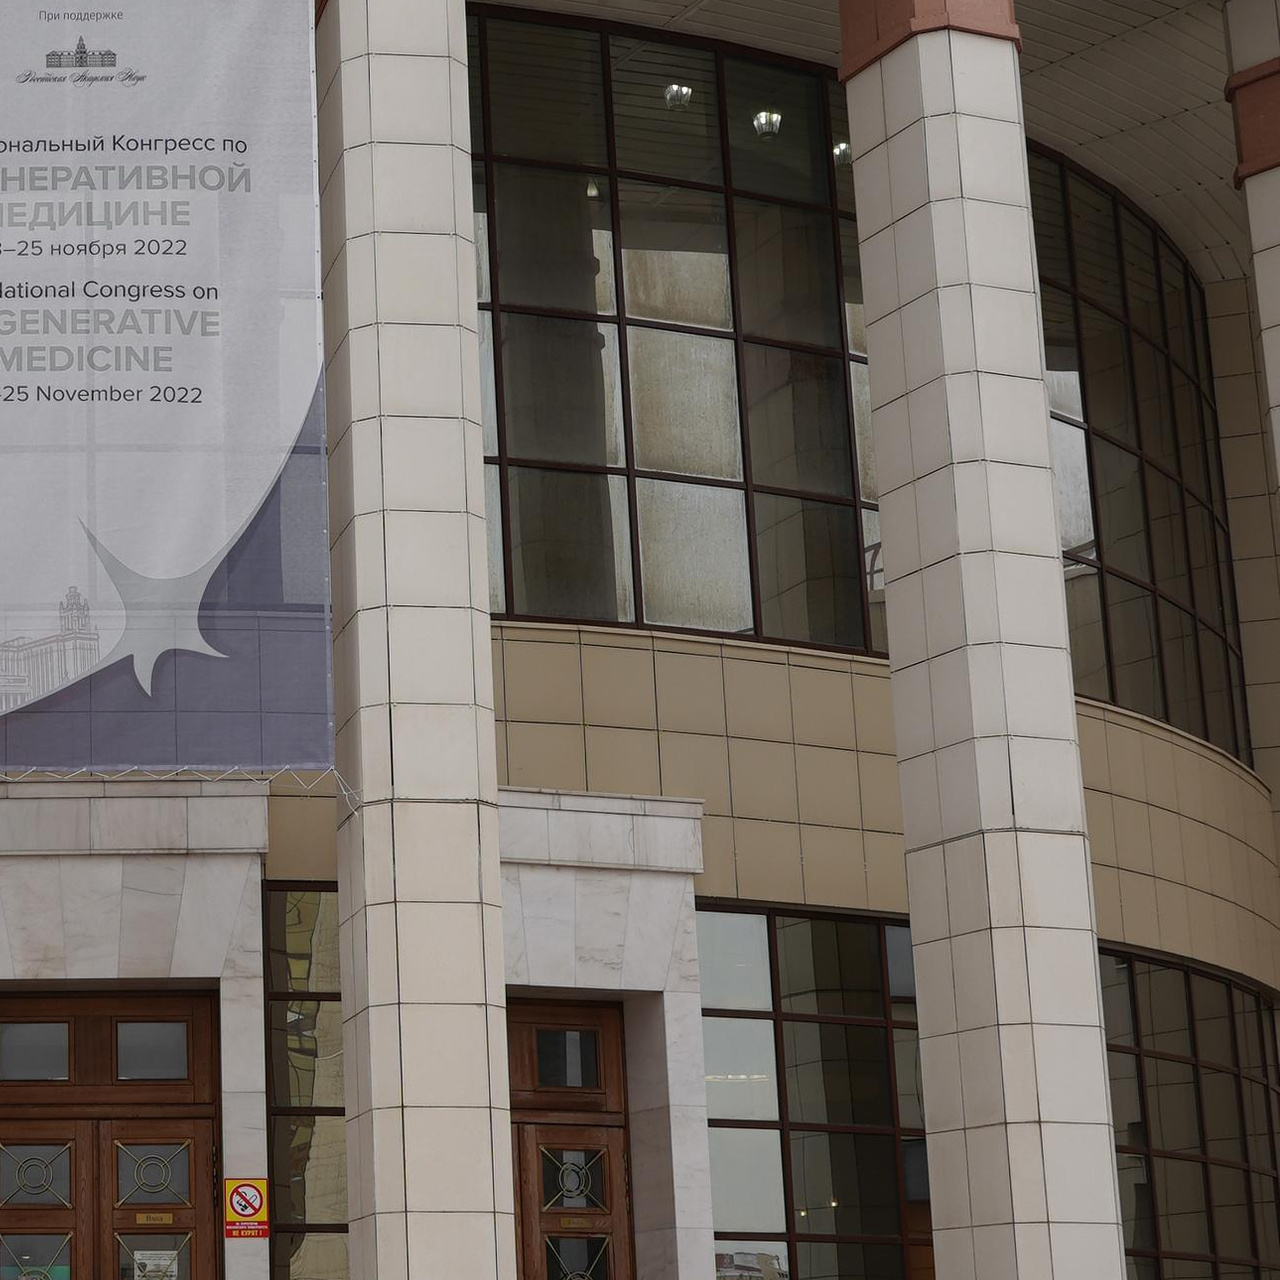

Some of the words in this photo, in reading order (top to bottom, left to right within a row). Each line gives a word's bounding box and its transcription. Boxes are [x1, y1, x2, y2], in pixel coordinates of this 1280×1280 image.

[39, 11, 59, 22] При
[64, 12, 123, 21] поддержке
[113, 135, 214, 154] Конгресс
[223, 140, 247, 153] по
[51, 240, 126, 258] ноября
[135, 240, 186, 255] 2022
[83, 281, 185, 302] Congress
[193, 286, 217, 299] on
[37, 386, 142, 401] November
[150, 386, 201, 403] 2022
